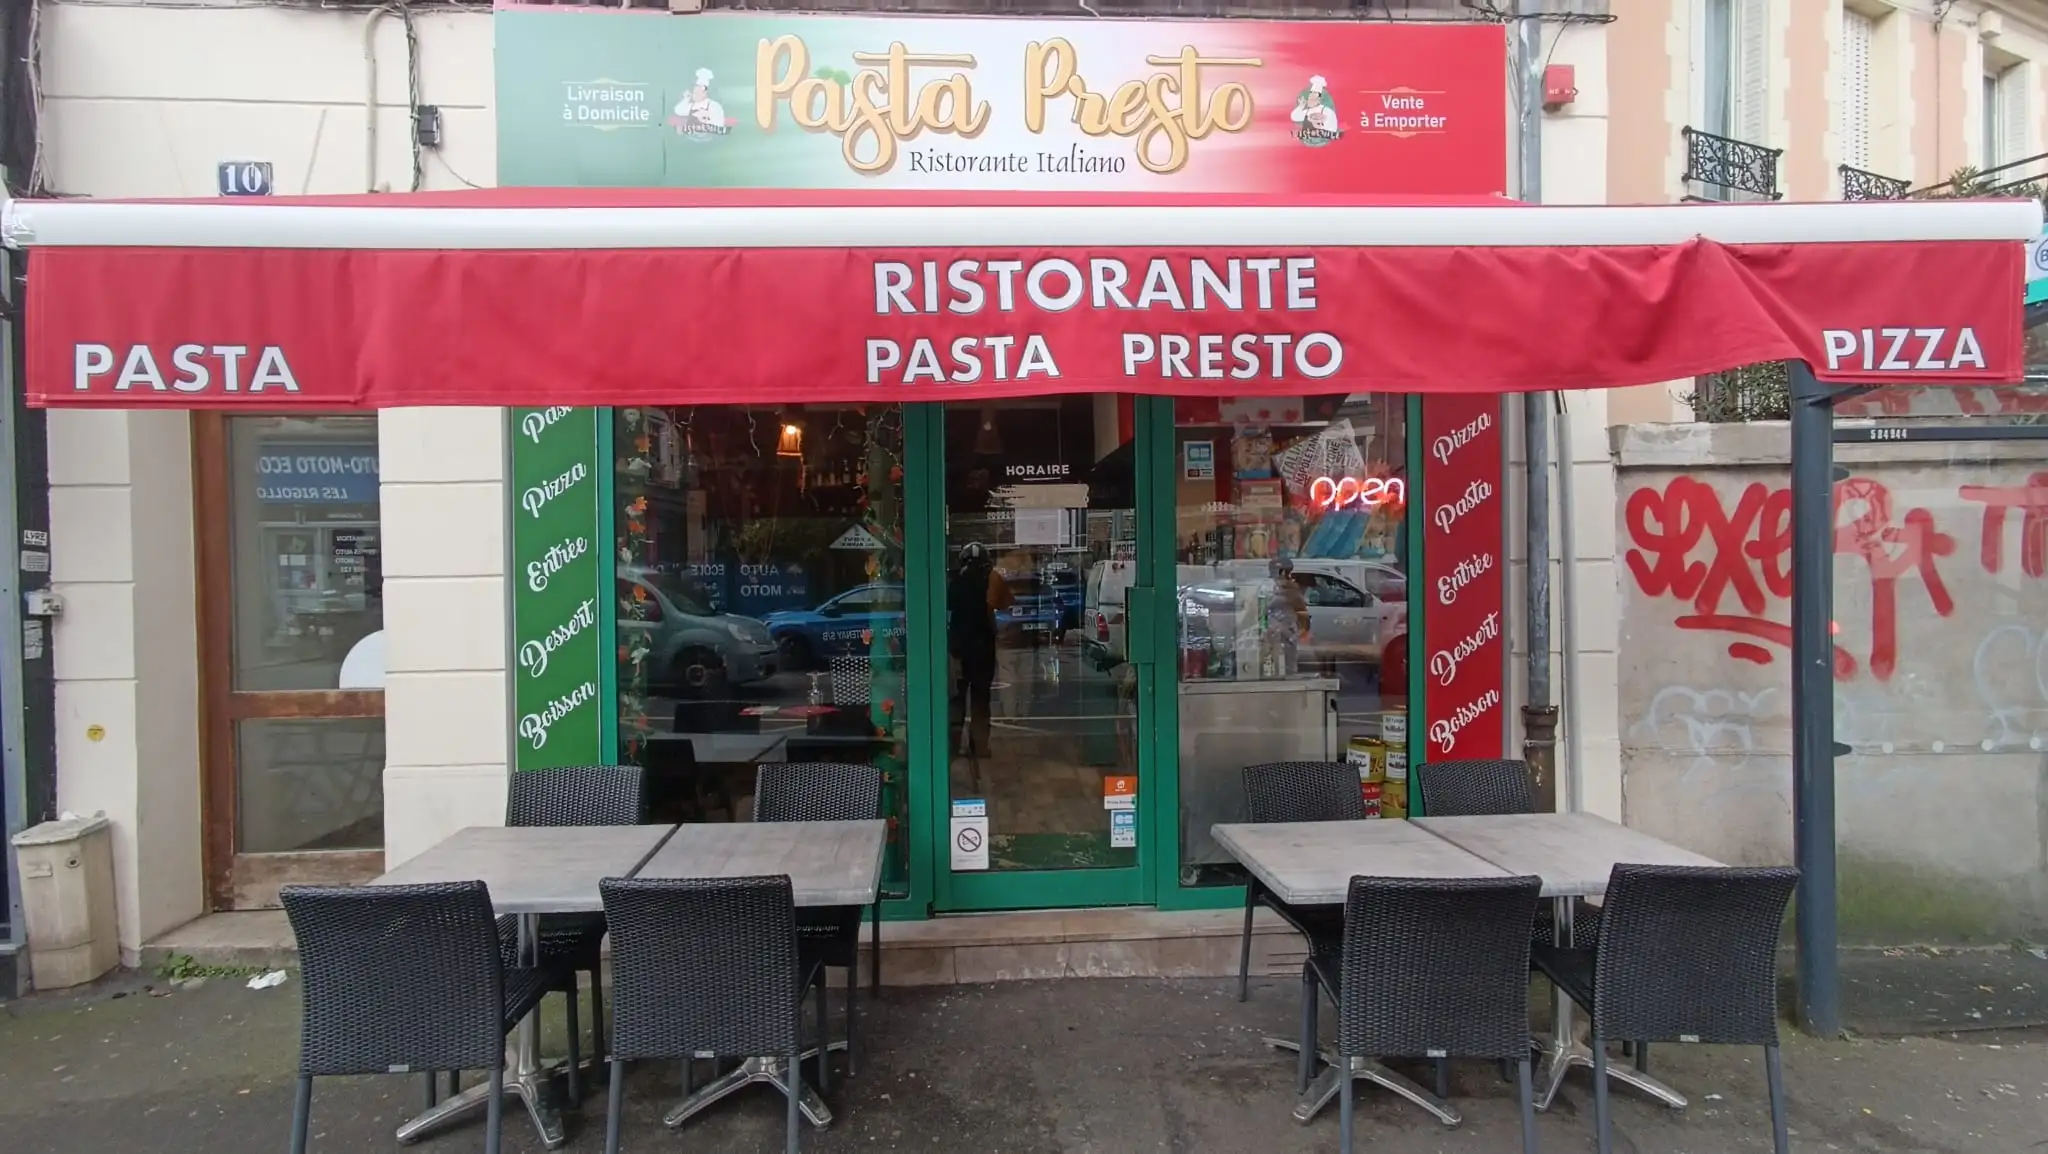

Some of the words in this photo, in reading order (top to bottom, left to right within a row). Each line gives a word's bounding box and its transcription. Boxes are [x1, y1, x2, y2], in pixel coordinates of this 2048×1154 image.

[562, 103, 573, 120] à
[578, 104, 650, 121] Domicile
[567, 85, 645, 102] Livraison
[756, 34, 991, 177] Pasta
[1025, 37, 1262, 174] Presto
[1381, 95, 1425, 110] Vente
[1360, 112, 1370, 127] à
[1374, 113, 1447, 131] Emporter
[225, 163, 263, 193] 10
[910, 148, 1028, 173] Ristorante
[1037, 143, 1125, 173] Italiano
[874, 257, 1317, 313] RISTORANTE
[75, 343, 299, 392] PASTA
[866, 334, 1060, 382] PASTA
[1122, 332, 1343, 379] PRESTO
[1822, 327, 1986, 370] PIZZA
[522, 406, 573, 444] Pas
[1432, 411, 1491, 465] Pizza
[522, 462, 587, 518] Pizza
[1006, 464, 1070, 476] HORAIRE
[1310, 476, 1404, 511] open
[1434, 479, 1492, 534] Pasta
[527, 536, 588, 592] Entrée
[1437, 553, 1492, 605] Entrée
[519, 598, 594, 678] Dessert
[1430, 611, 1498, 686] Dessert
[519, 682, 595, 750] Boisson
[1429, 688, 1499, 754] Boisson
